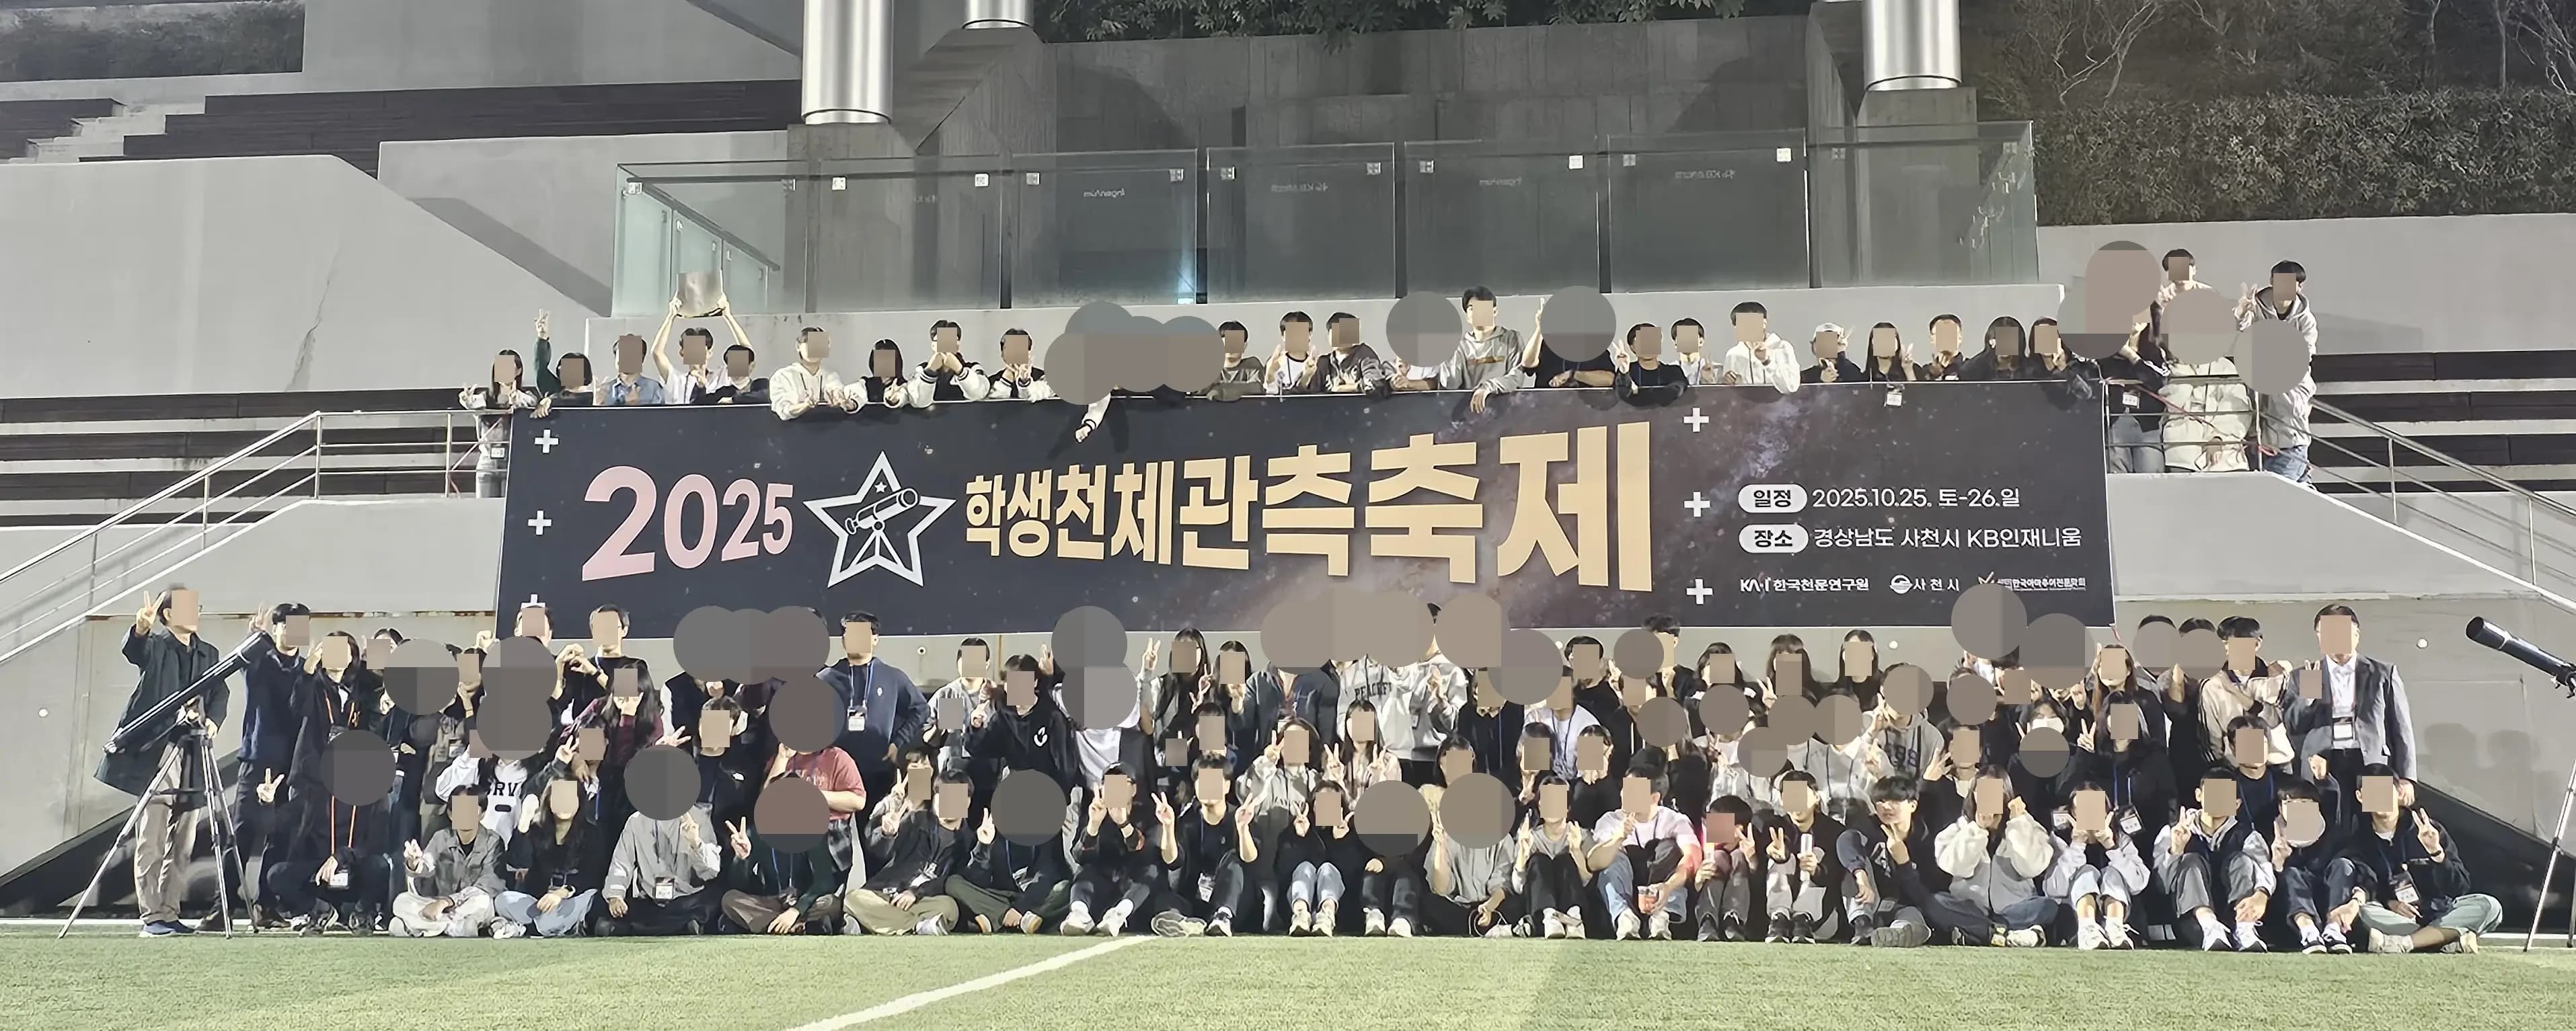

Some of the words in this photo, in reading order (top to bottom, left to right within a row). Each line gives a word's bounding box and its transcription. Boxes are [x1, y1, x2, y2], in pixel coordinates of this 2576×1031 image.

[964, 421, 1653, 592] 학생천체관측축제
[1753, 490, 1792, 508] 일정
[1812, 488, 1932, 507] 2025.10.25.
[1938, 488, 2020, 507] 토-26.일
[582, 465, 794, 582] 2025
[1754, 529, 1793, 547] 장소
[1814, 528, 1895, 547] 경상남도
[1900, 527, 1960, 548] 사천시
[1967, 527, 2082, 548] KB인재니움
[1773, 578, 1869, 591] 한국천문연구원
